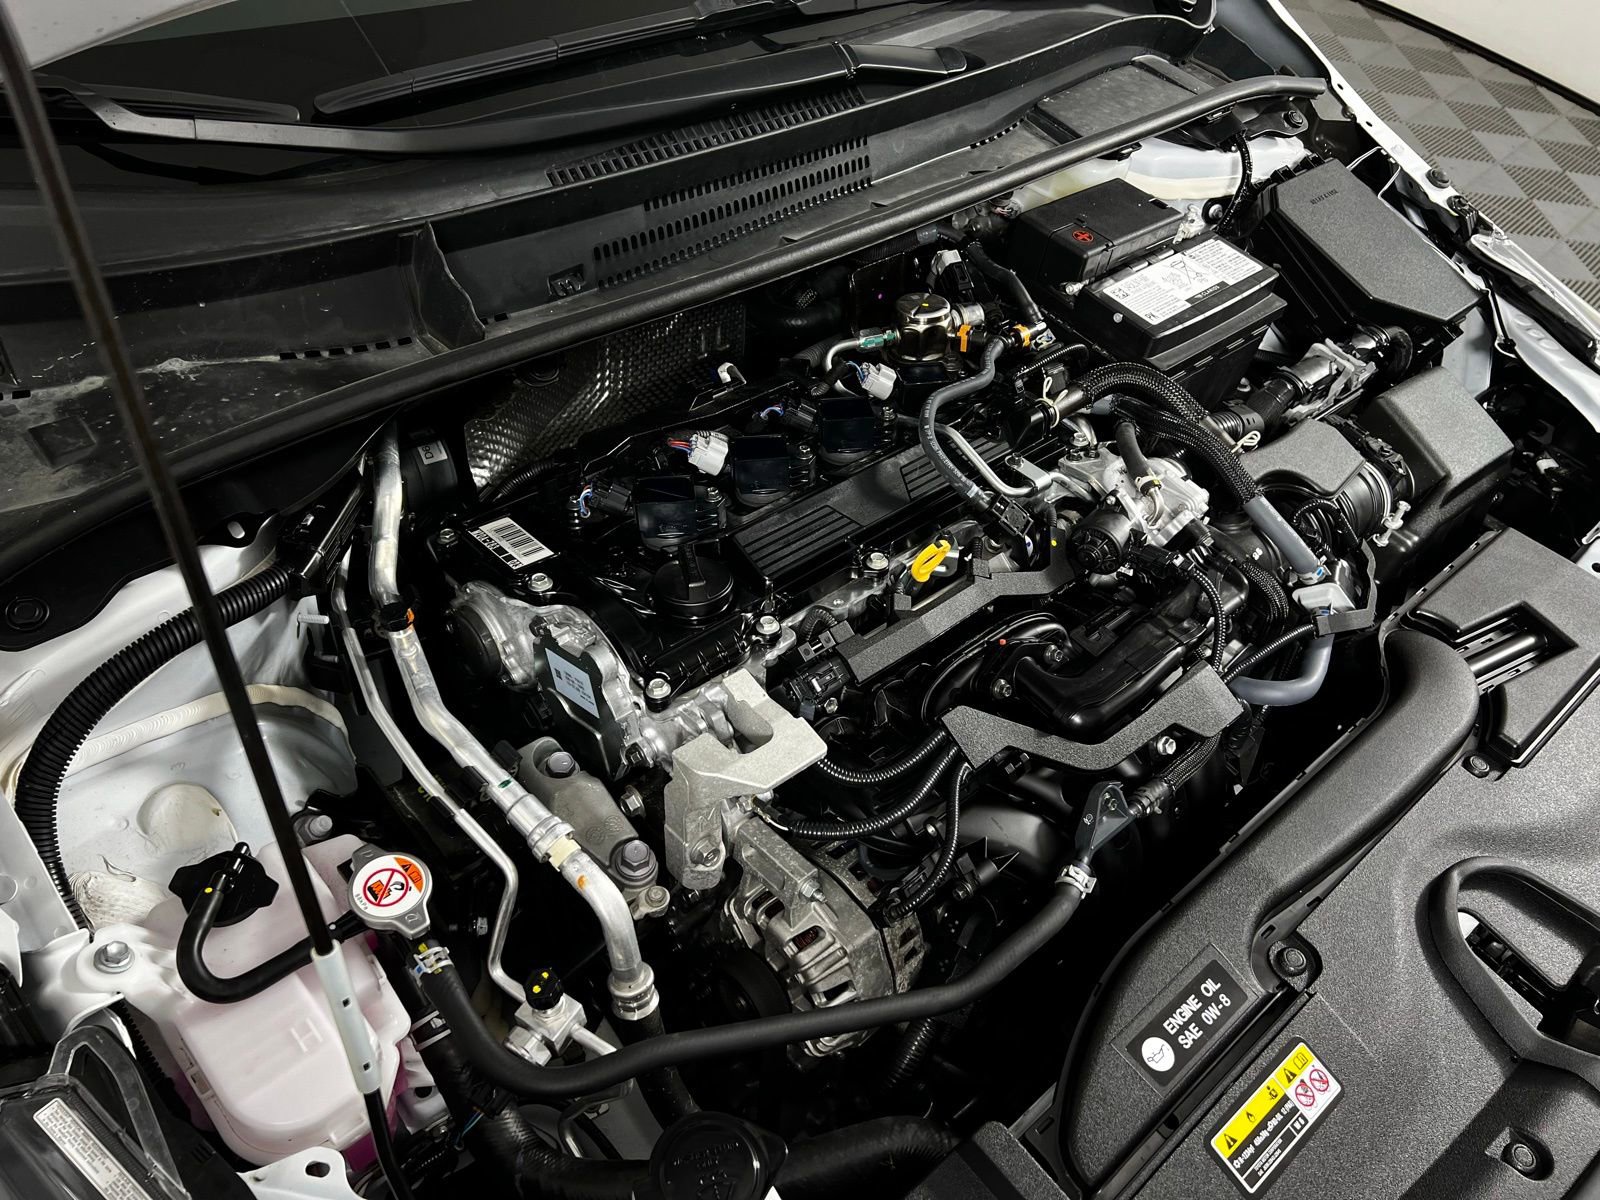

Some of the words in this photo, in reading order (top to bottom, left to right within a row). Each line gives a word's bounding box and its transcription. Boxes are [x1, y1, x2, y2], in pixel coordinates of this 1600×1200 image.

[1162, 994, 1203, 1035] ENGINE
[1200, 978, 1222, 997] OIL
[1178, 1022, 1203, 1049] SAE
[1201, 993, 1231, 1025] 0W-8
